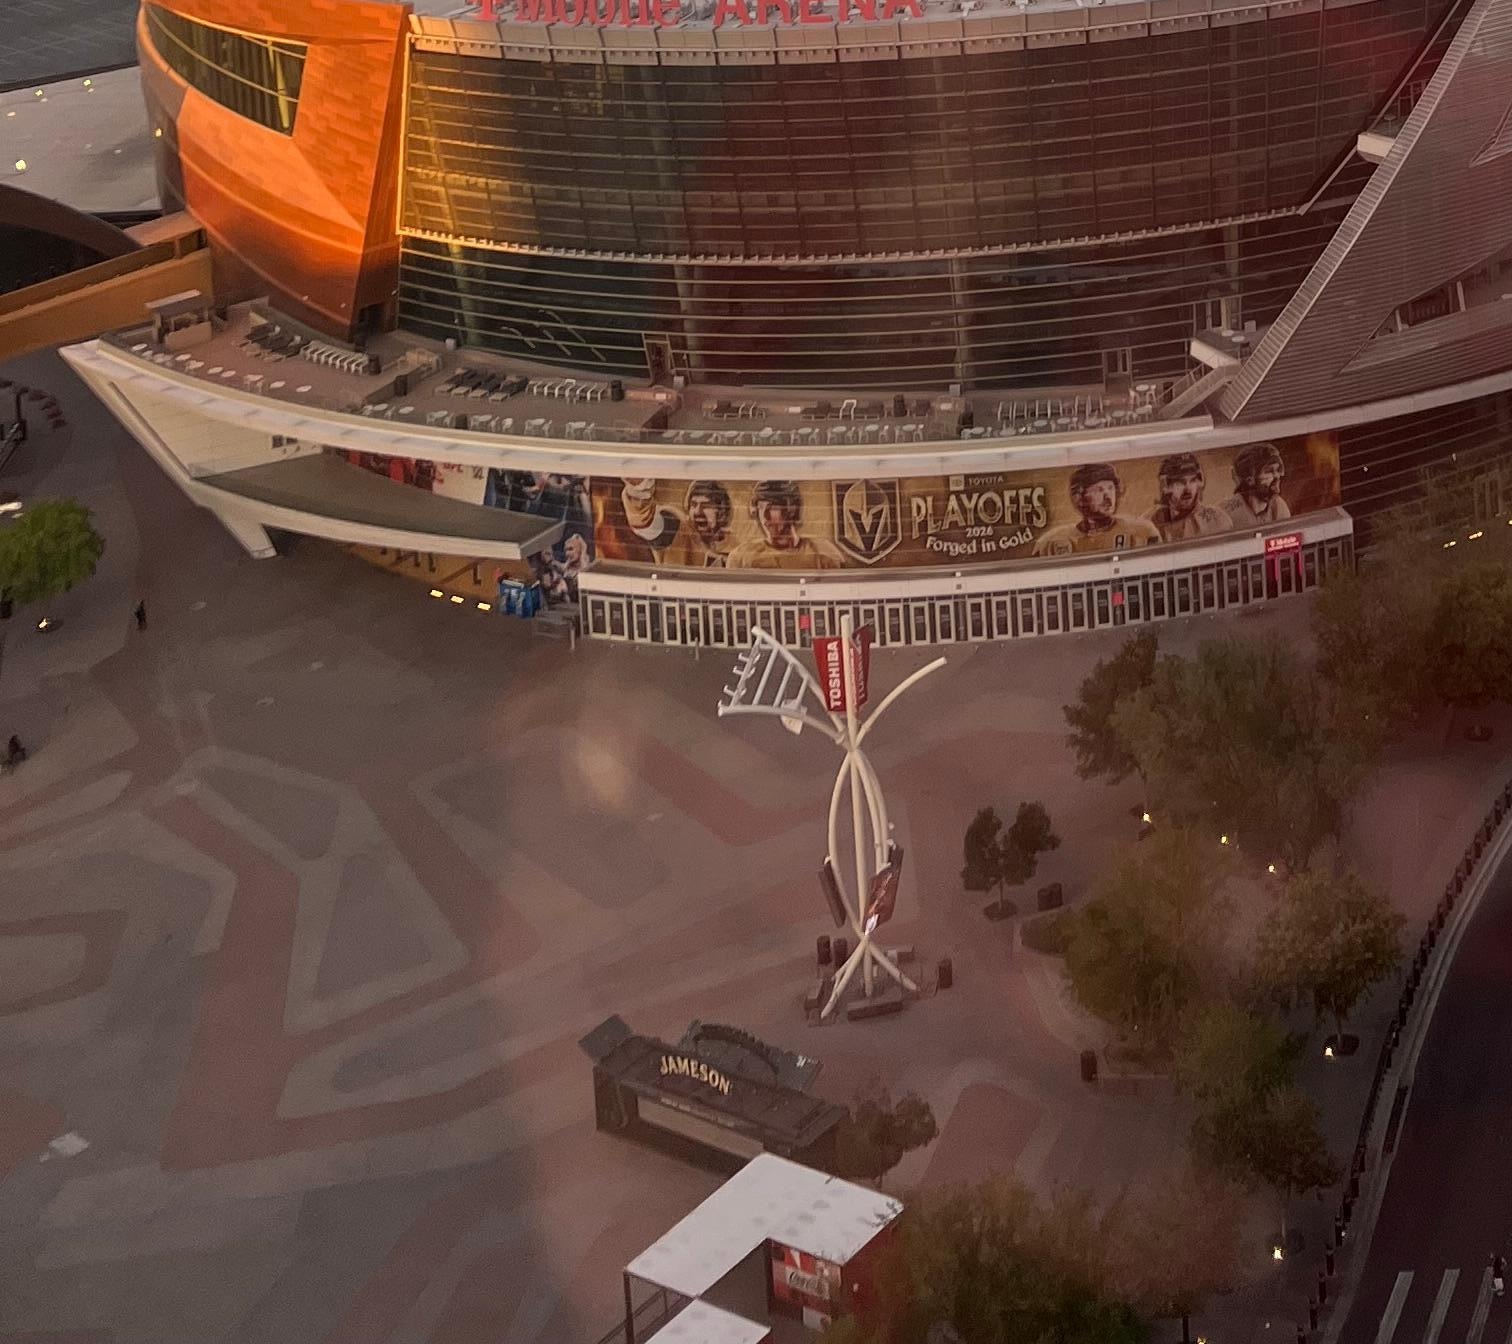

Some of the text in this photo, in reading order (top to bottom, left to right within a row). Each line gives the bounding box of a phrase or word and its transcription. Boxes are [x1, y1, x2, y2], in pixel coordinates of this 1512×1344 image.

[968, 475, 1004, 486] TOYOTA
[910, 486, 1048, 540] PLAYOFFS
[926, 528, 1034, 557] Forged in Gold
[827, 640, 842, 709] TOSHIBA
[660, 1055, 731, 1096] JAMESON
